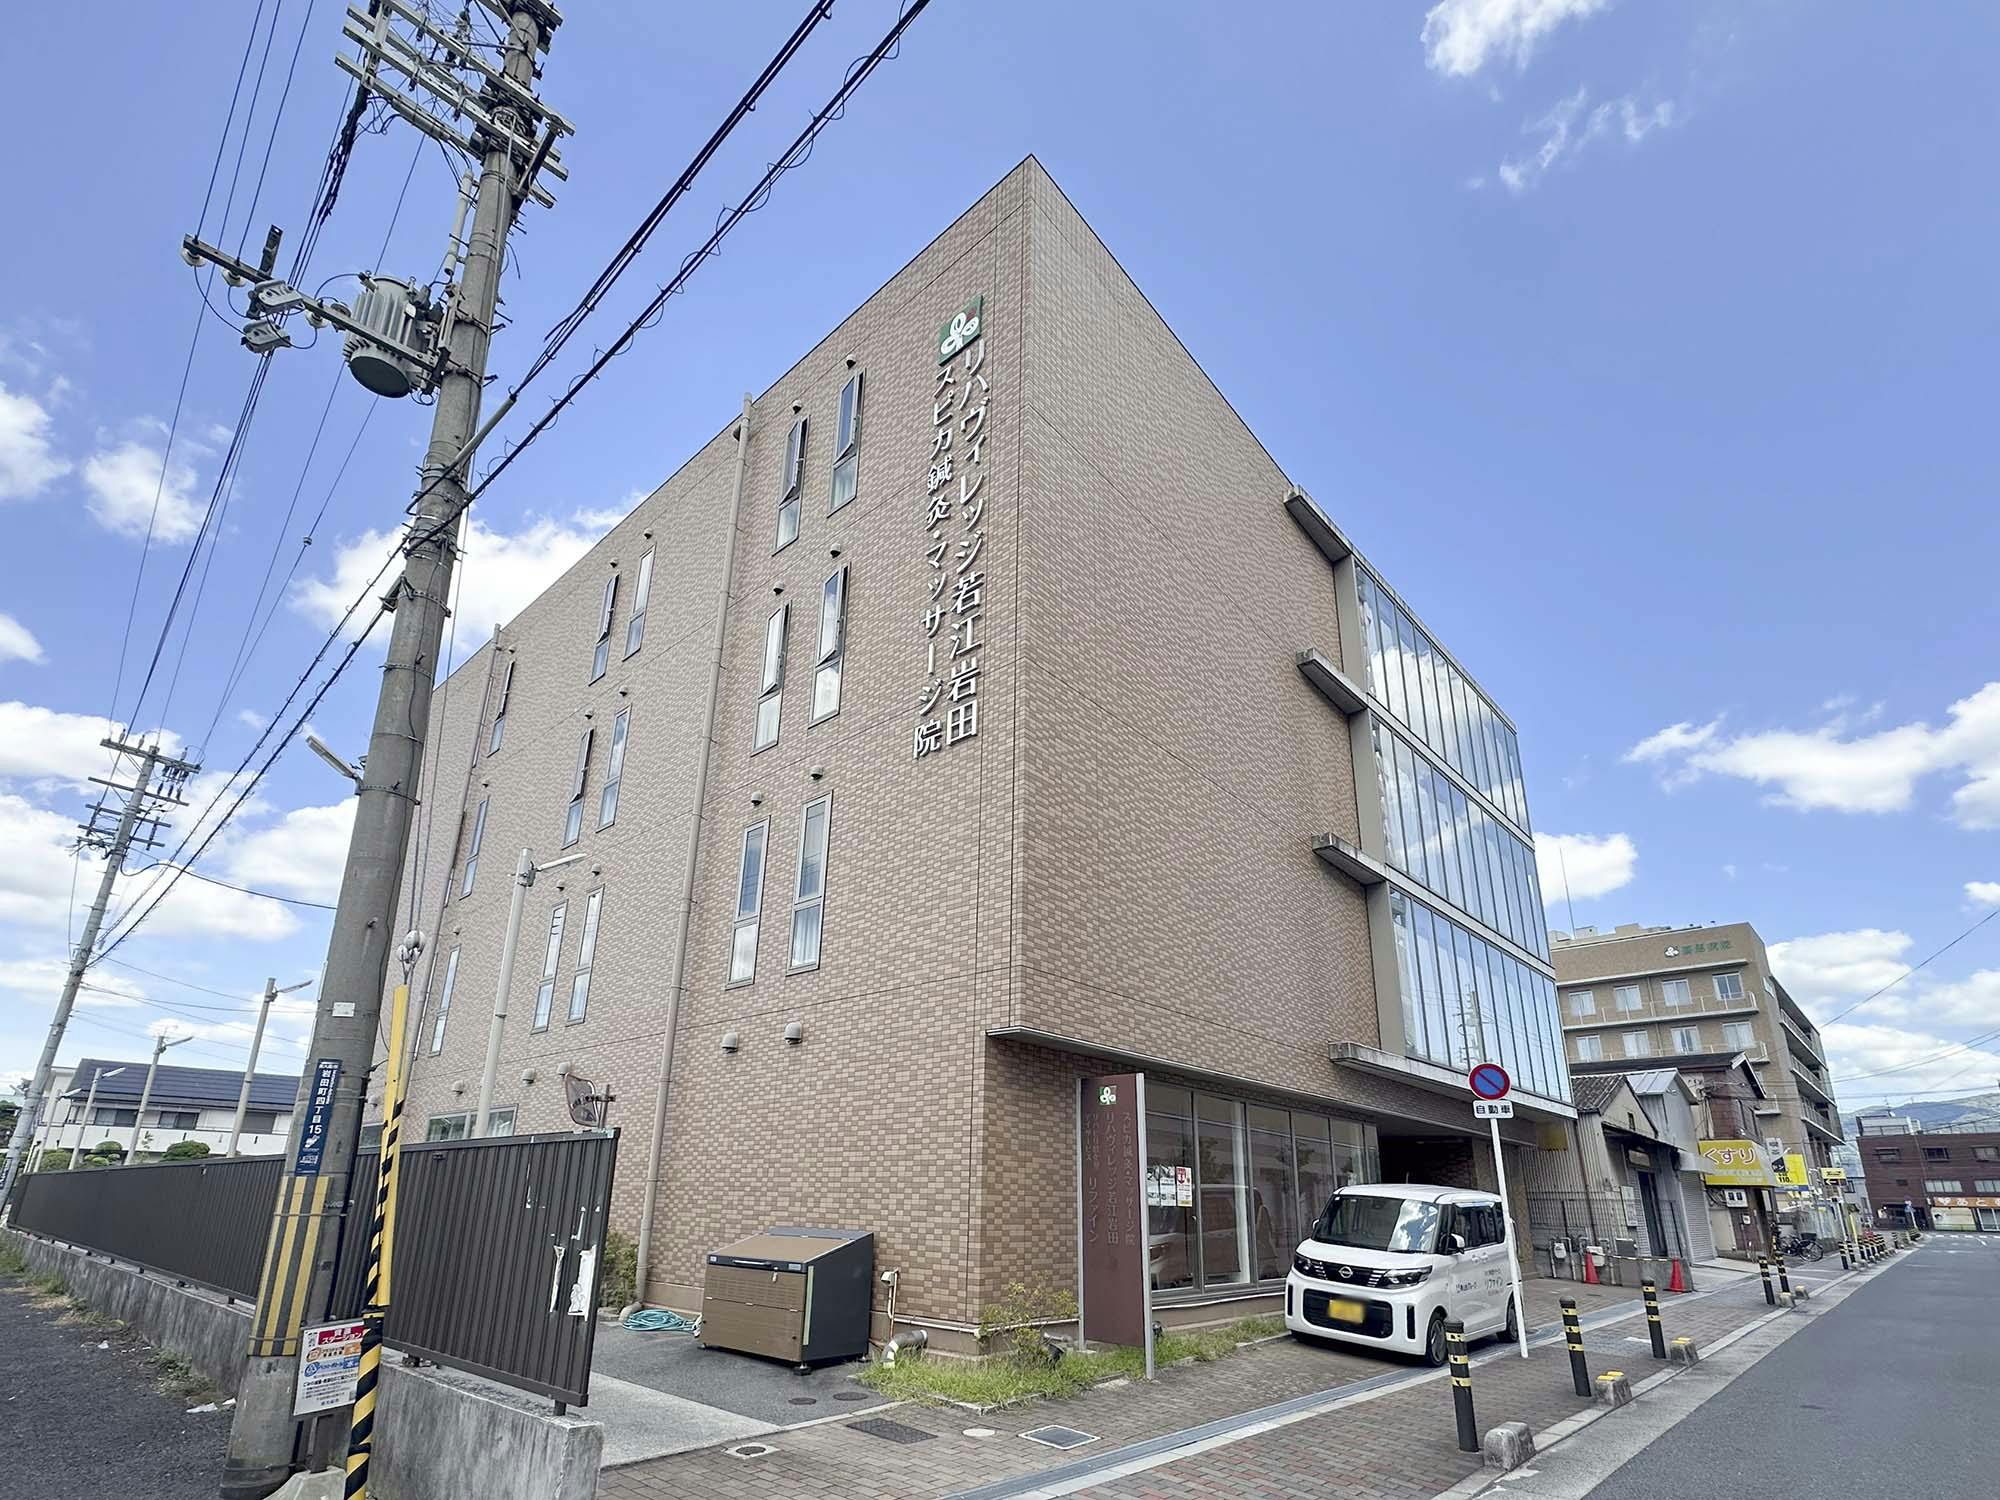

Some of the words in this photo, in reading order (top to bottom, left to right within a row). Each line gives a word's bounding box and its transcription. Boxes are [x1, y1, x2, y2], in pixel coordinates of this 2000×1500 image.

[912, 366, 956, 759] スピカ鍼灸・マッサージ院
[945, 338, 990, 746] リハヴィレッジ若江岩田
[1475, 1104, 1511, 1114] 自動車
[1704, 1148, 1756, 1164] くすり
[1104, 1112, 1120, 1245] リハヴィレッジ若江岩田
